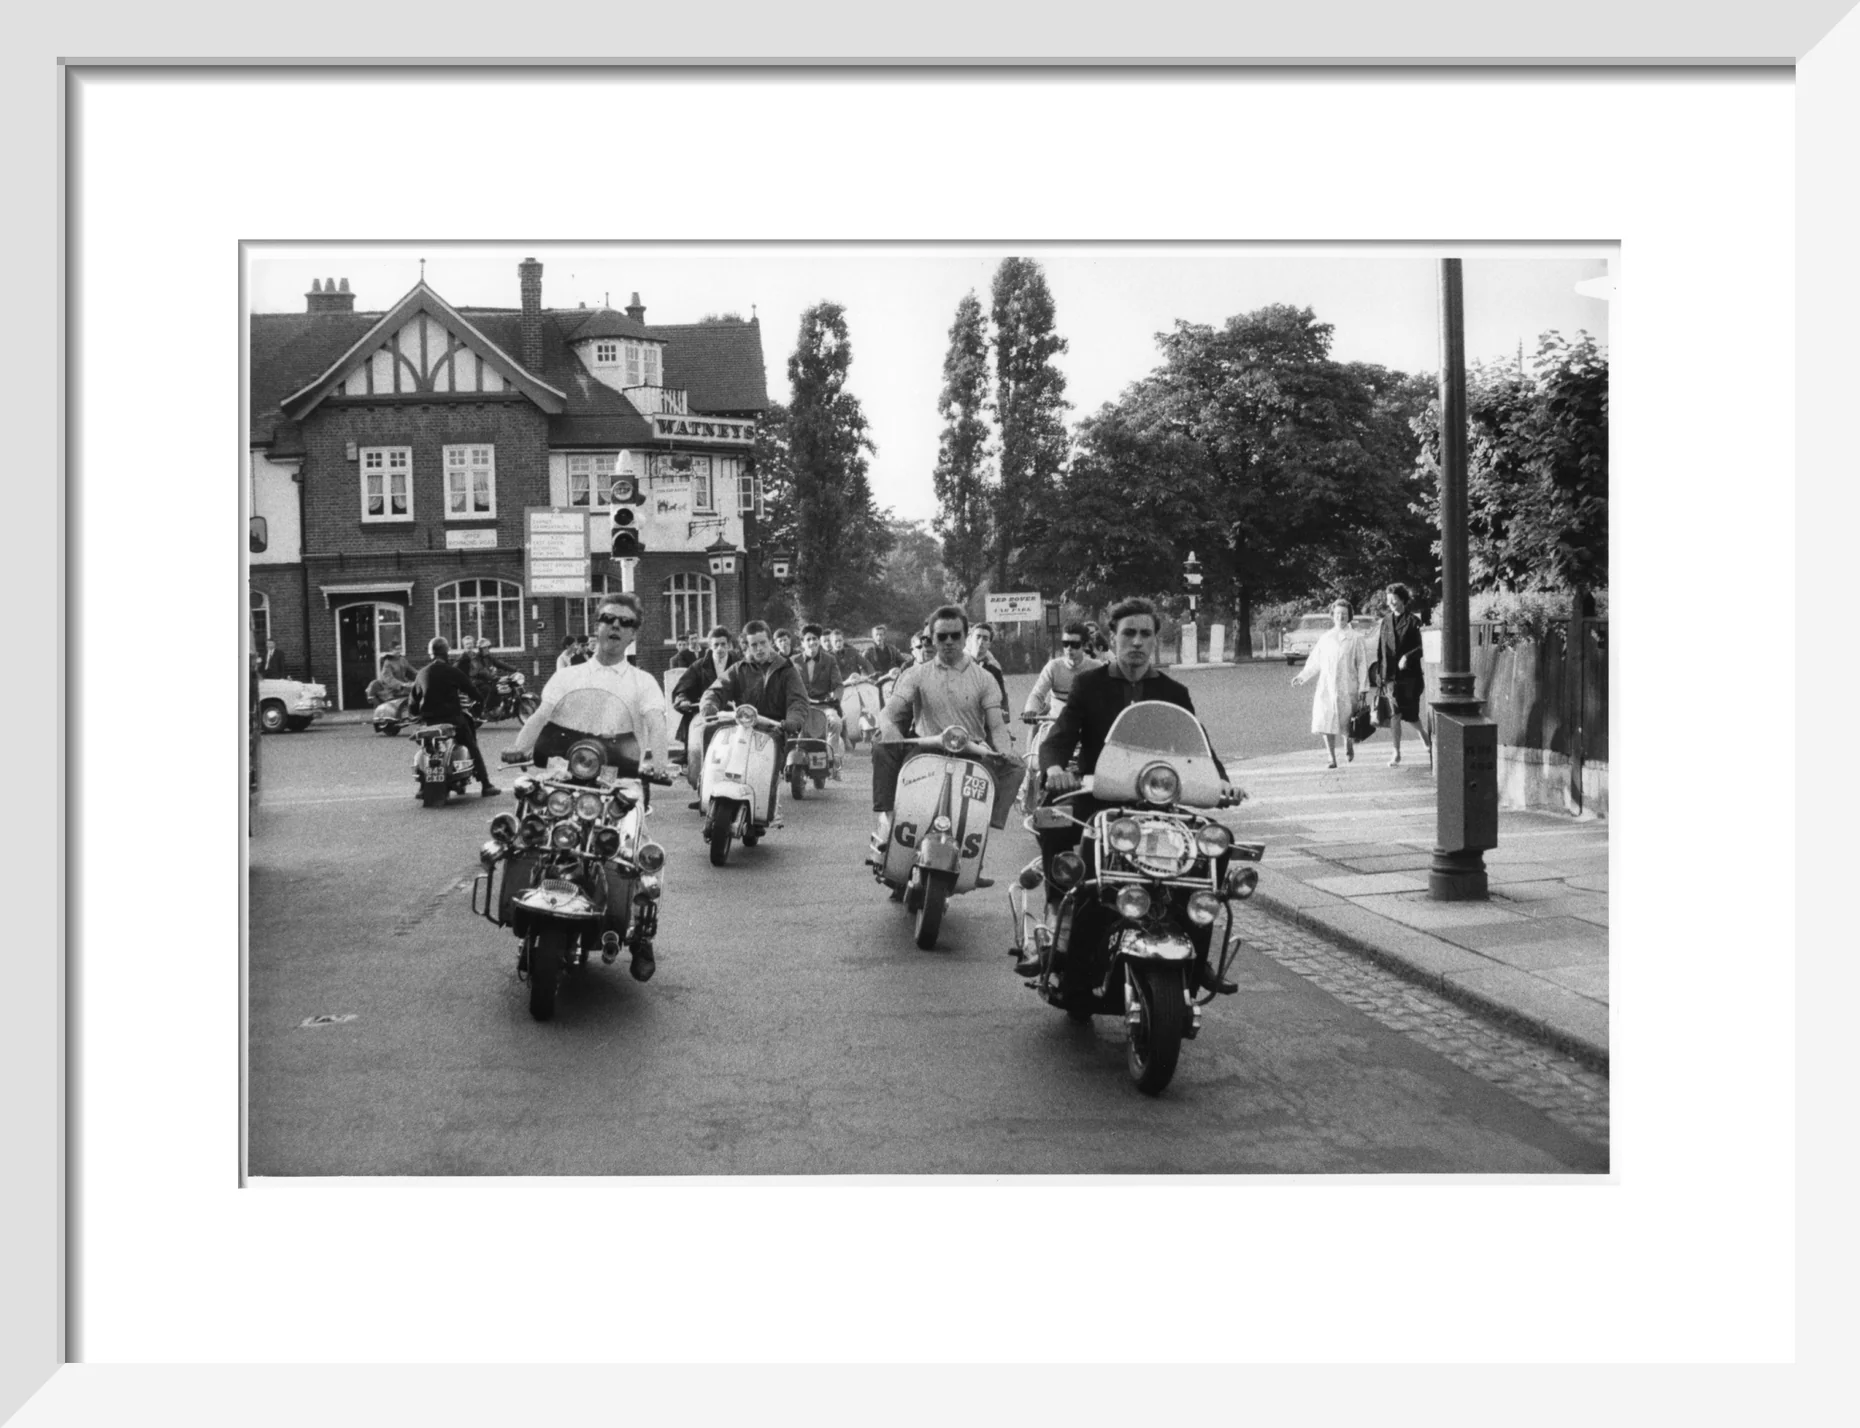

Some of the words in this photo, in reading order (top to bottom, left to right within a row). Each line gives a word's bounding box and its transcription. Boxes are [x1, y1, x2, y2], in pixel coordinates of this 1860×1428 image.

[655, 419, 755, 439] WATNEYS
[965, 775, 987, 790] 703
[963, 786, 985, 800] GYF
[894, 821, 918, 849] G
[962, 833, 982, 859] S
